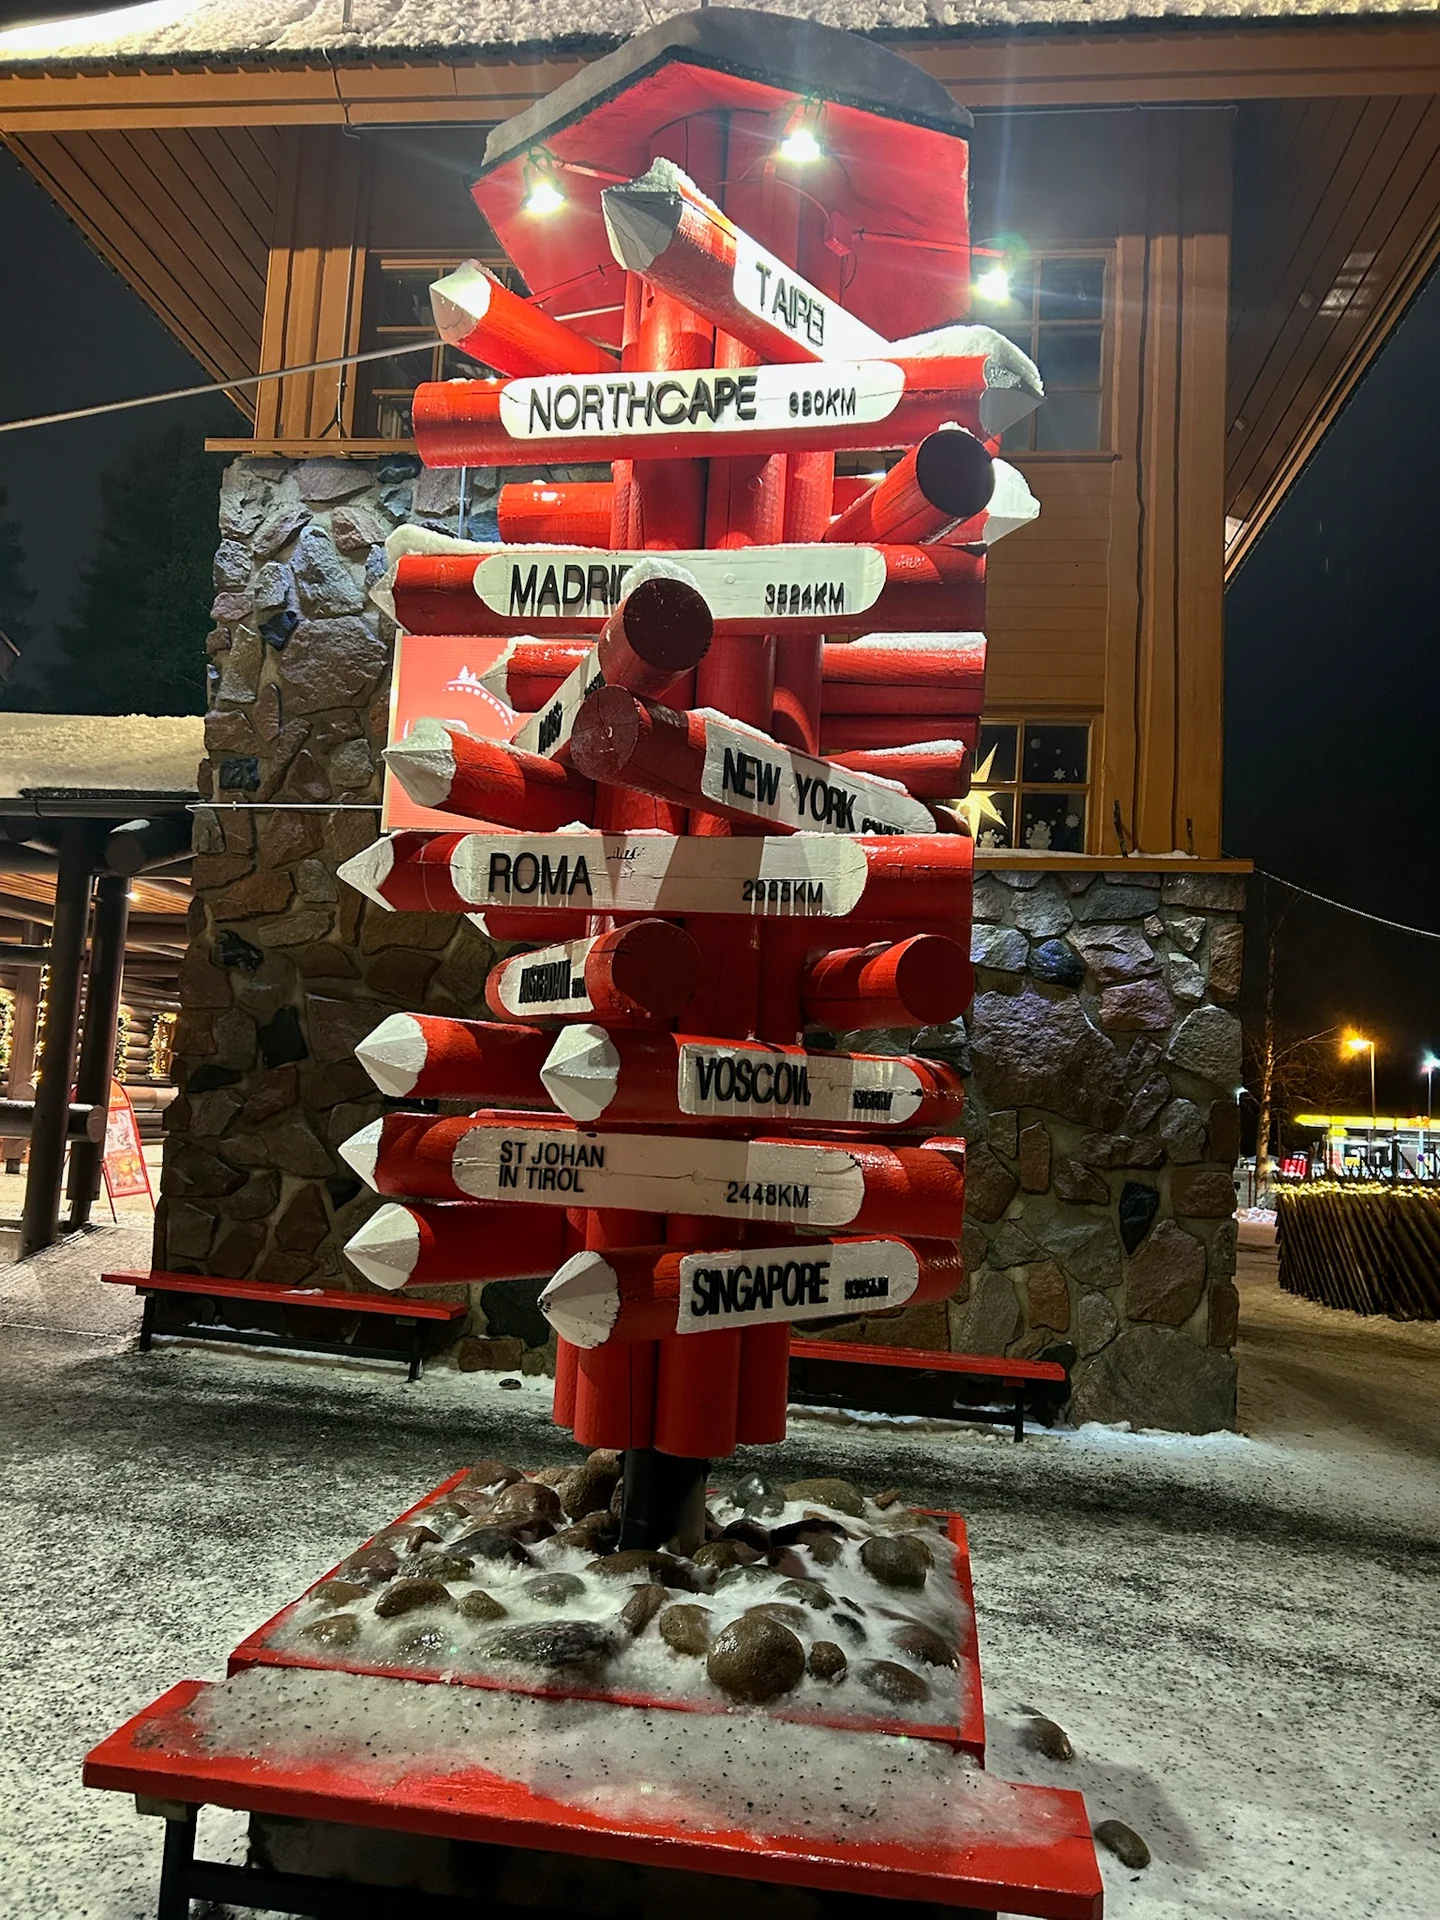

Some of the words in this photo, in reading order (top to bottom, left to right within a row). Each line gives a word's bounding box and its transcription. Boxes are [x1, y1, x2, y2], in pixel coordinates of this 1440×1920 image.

[529, 375, 758, 434] NORTHCAPE
[722, 747, 782, 806] NEW
[795, 773, 856, 833] YORK
[488, 852, 593, 896] ROMA
[500, 1140, 526, 1165] ST
[531, 1142, 605, 1168] JOHAN
[499, 1165, 518, 1188] IN
[526, 1167, 585, 1193] TIROL
[726, 1181, 809, 1208] 2448KM
[691, 1261, 831, 1317] SINGAPORE
